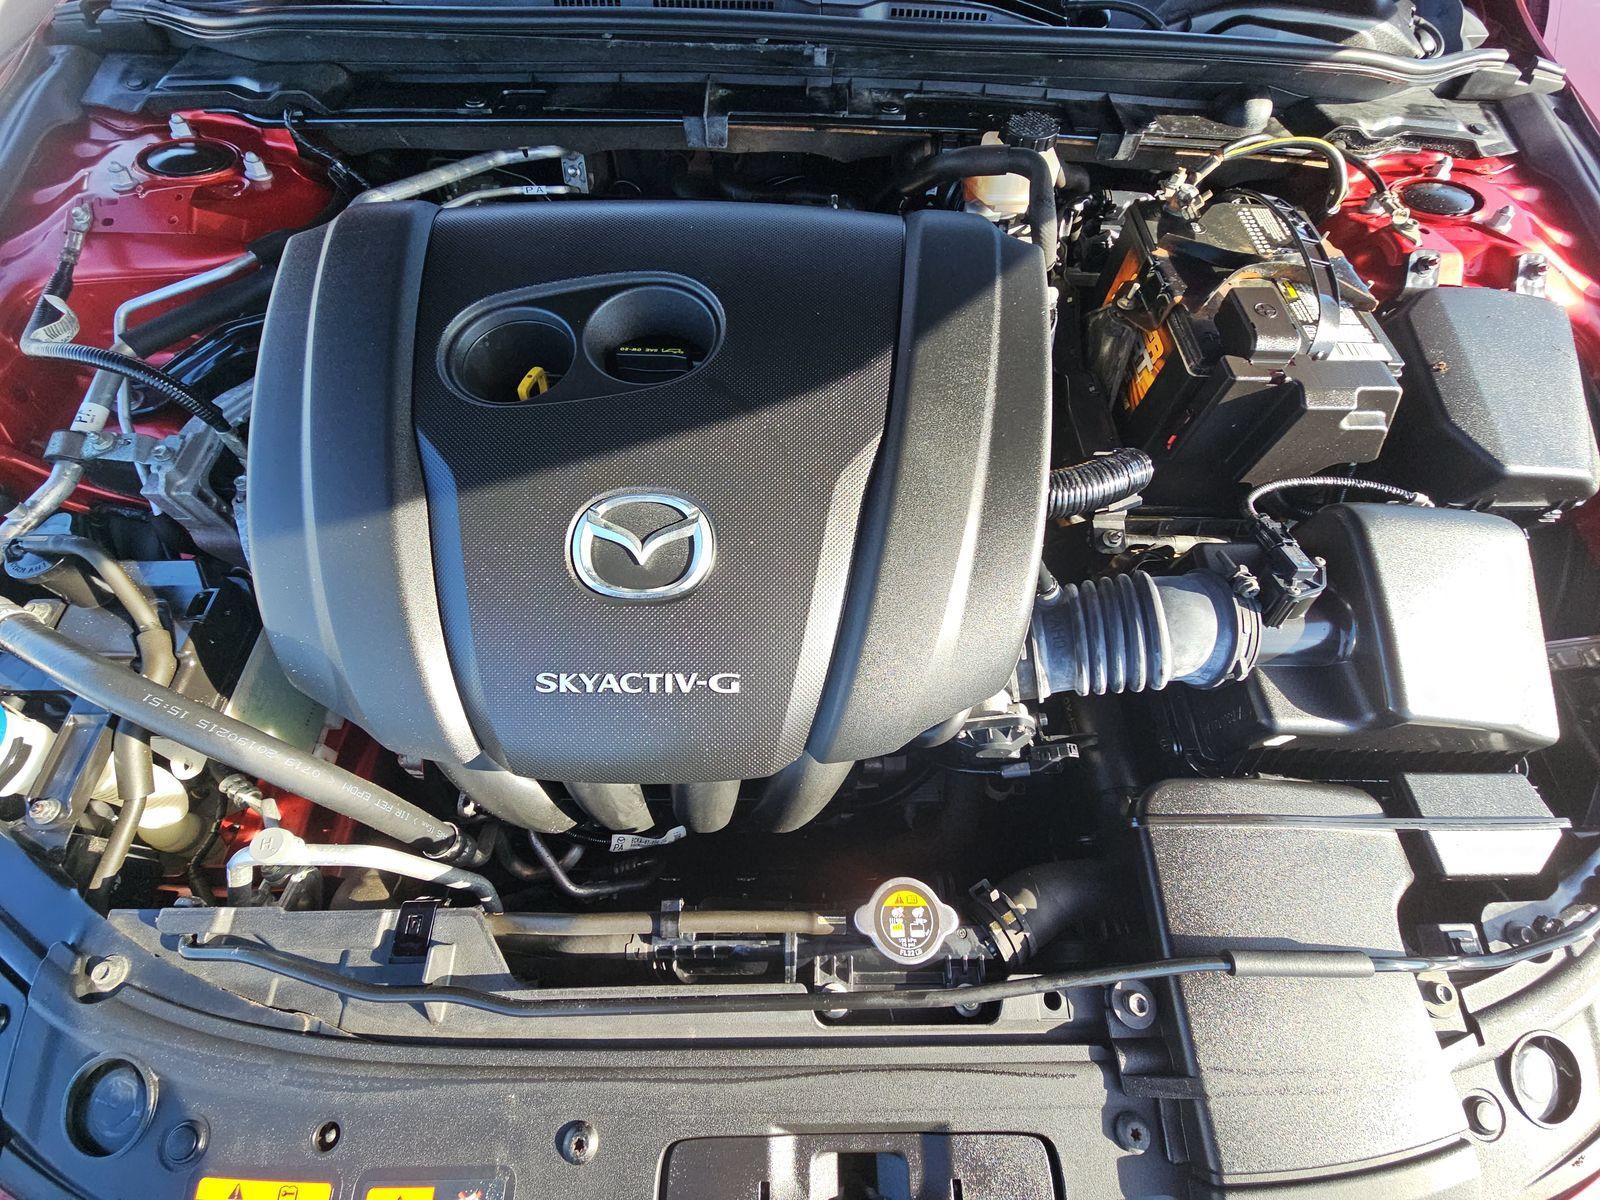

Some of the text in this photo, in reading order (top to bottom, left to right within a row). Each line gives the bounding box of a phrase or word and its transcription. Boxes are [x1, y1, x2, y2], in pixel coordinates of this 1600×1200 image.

[525, 186, 544, 194] PA
[535, 672, 741, 694] SKYACTIV-G
[142, 693, 190, 719] 15:51
[195, 719, 279, 759] 20190215
[342, 782, 372, 801] EPDM
[259, 836, 274, 851] H
[612, 843, 624, 851] PA
[899, 949, 915, 957] FL22
